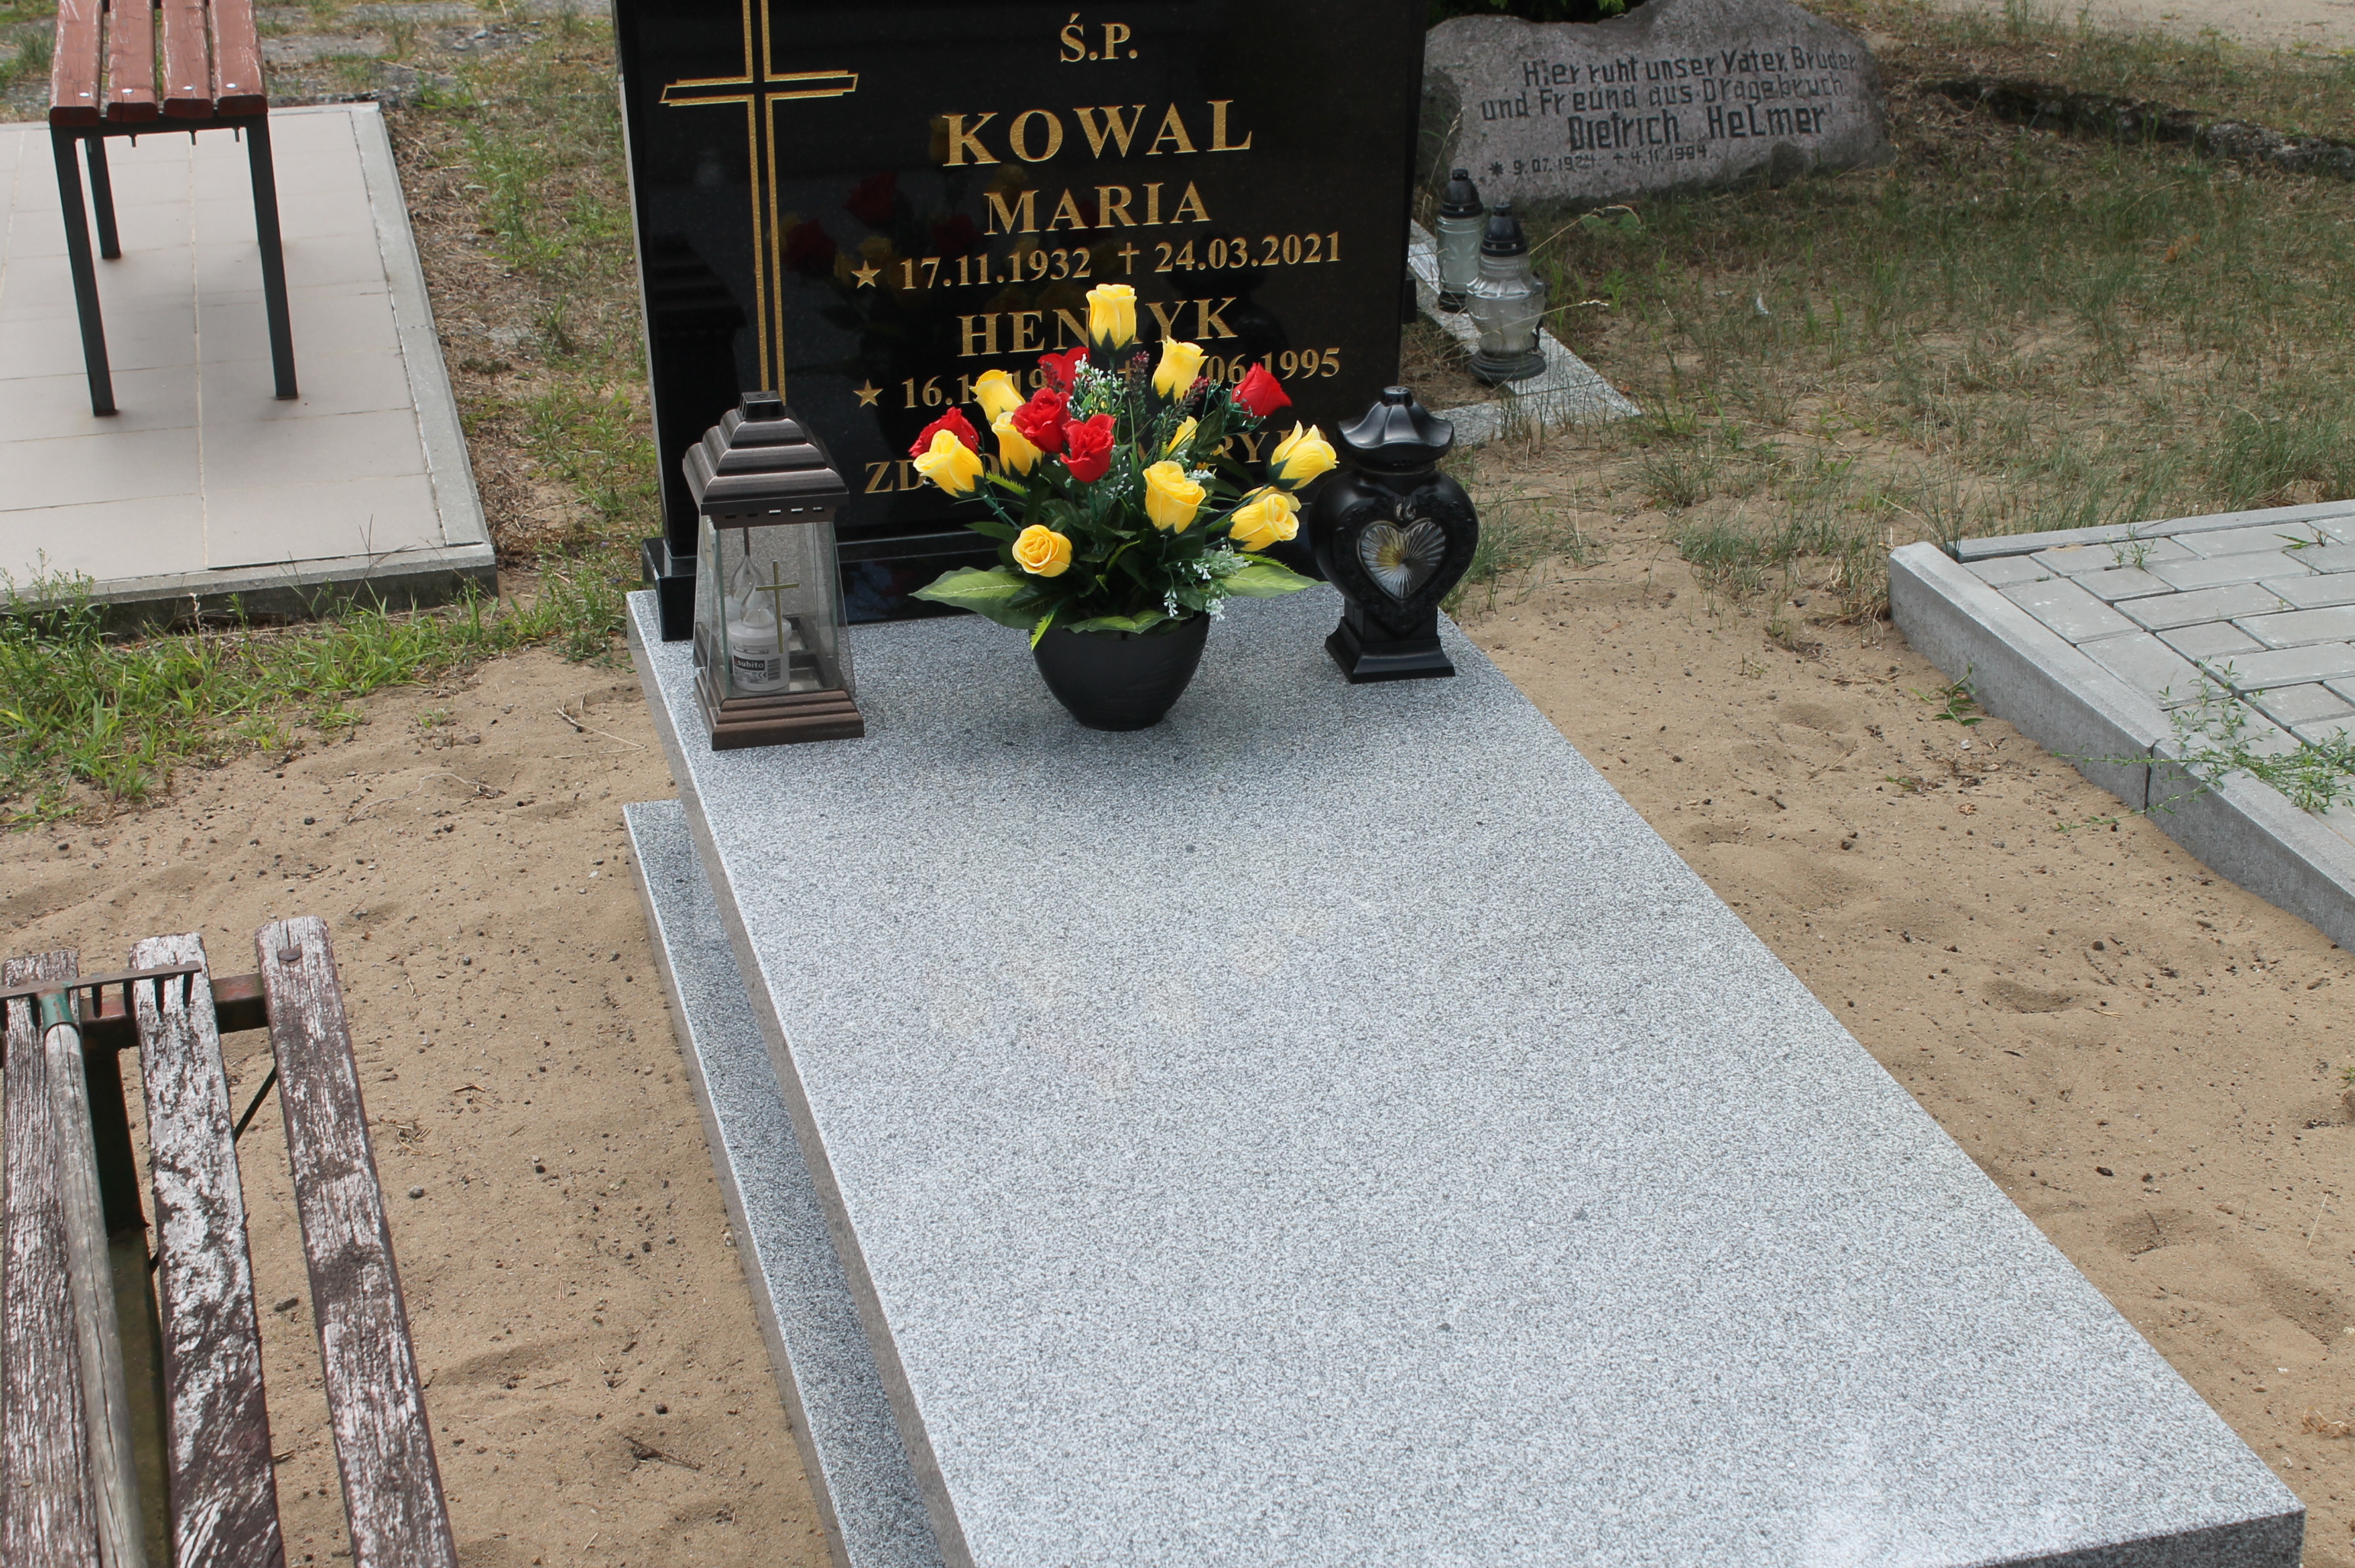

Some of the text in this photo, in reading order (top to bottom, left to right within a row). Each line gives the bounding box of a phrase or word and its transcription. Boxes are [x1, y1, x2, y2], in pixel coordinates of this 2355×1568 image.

[1060, 12, 1139, 63] Ś.P.
[1523, 45, 1856, 87] Hier ruht unser Vater, Bruder
[1481, 72, 1846, 121] und Freund aus Dragebruch
[942, 99, 1252, 166] KOWAL
[1567, 108, 1681, 153] Dietrich
[984, 180, 1212, 236] MARIA
[900, 231, 1342, 291] 17.11.1932 24.03.2021
[956, 297, 1239, 358] HENYK
